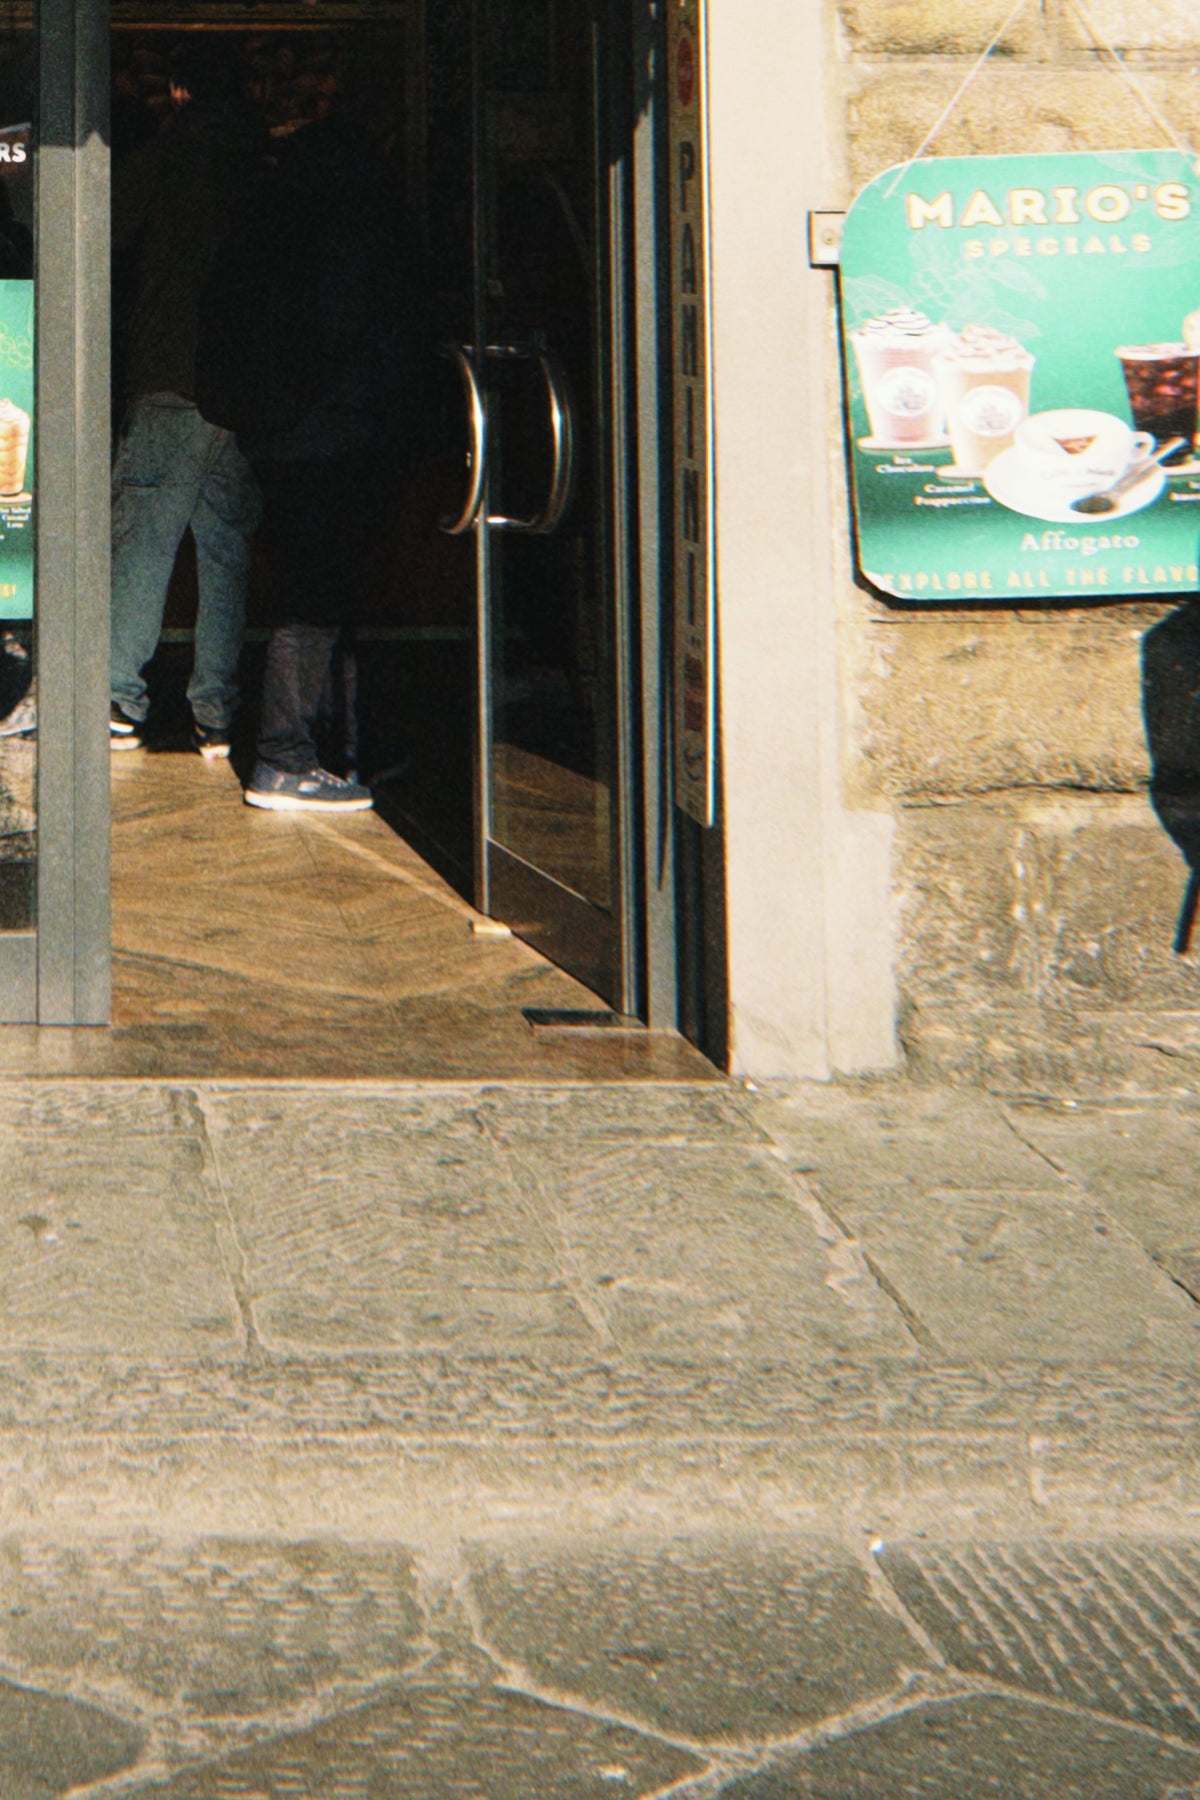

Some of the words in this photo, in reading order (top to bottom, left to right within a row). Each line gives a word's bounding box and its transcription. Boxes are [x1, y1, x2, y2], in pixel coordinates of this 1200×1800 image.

[905, 182, 1192, 230] MARIO'S
[964, 234, 1151, 259] SPECIALS
[1020, 530, 1141, 556] Affogato
[1007, 568, 1051, 588] ALL
[1065, 567, 1109, 587] THE
